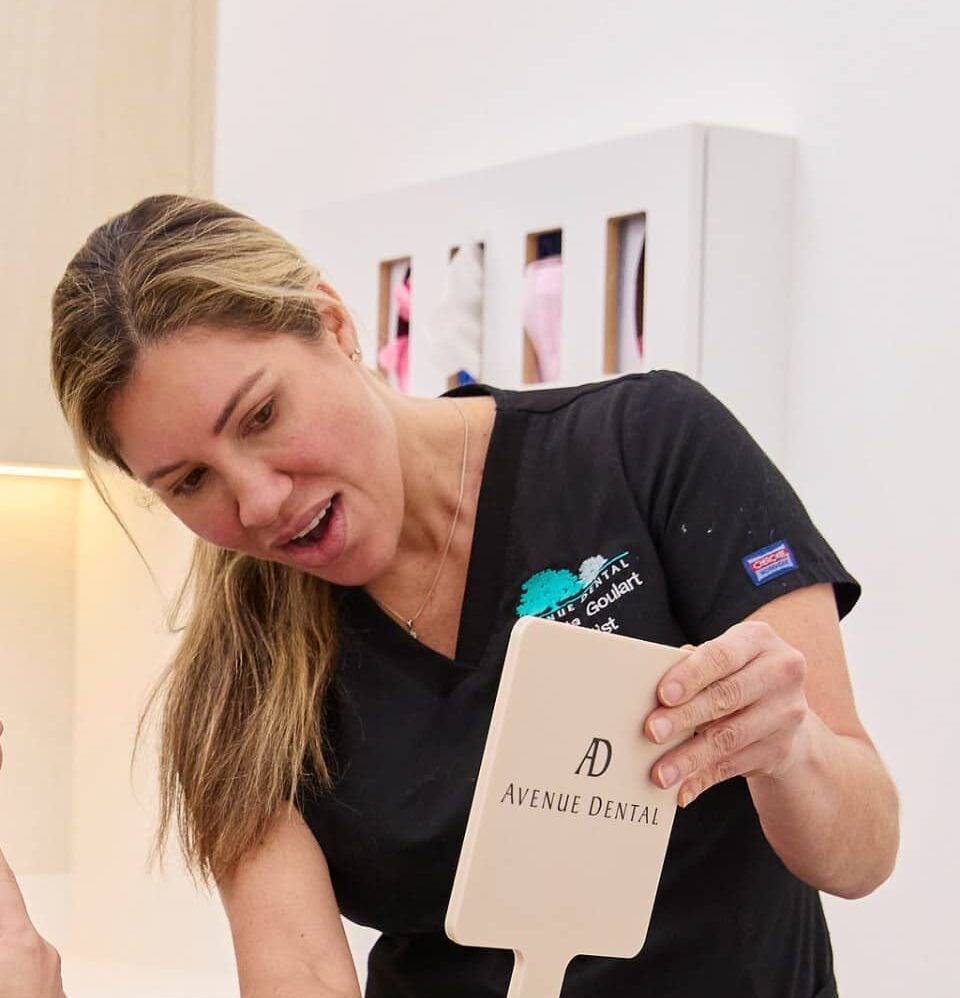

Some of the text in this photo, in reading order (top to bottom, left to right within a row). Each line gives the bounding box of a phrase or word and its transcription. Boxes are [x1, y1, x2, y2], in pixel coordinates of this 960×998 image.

[586, 571, 644, 617] Goulart
[500, 783, 659, 826] AVENUE DENTAL
